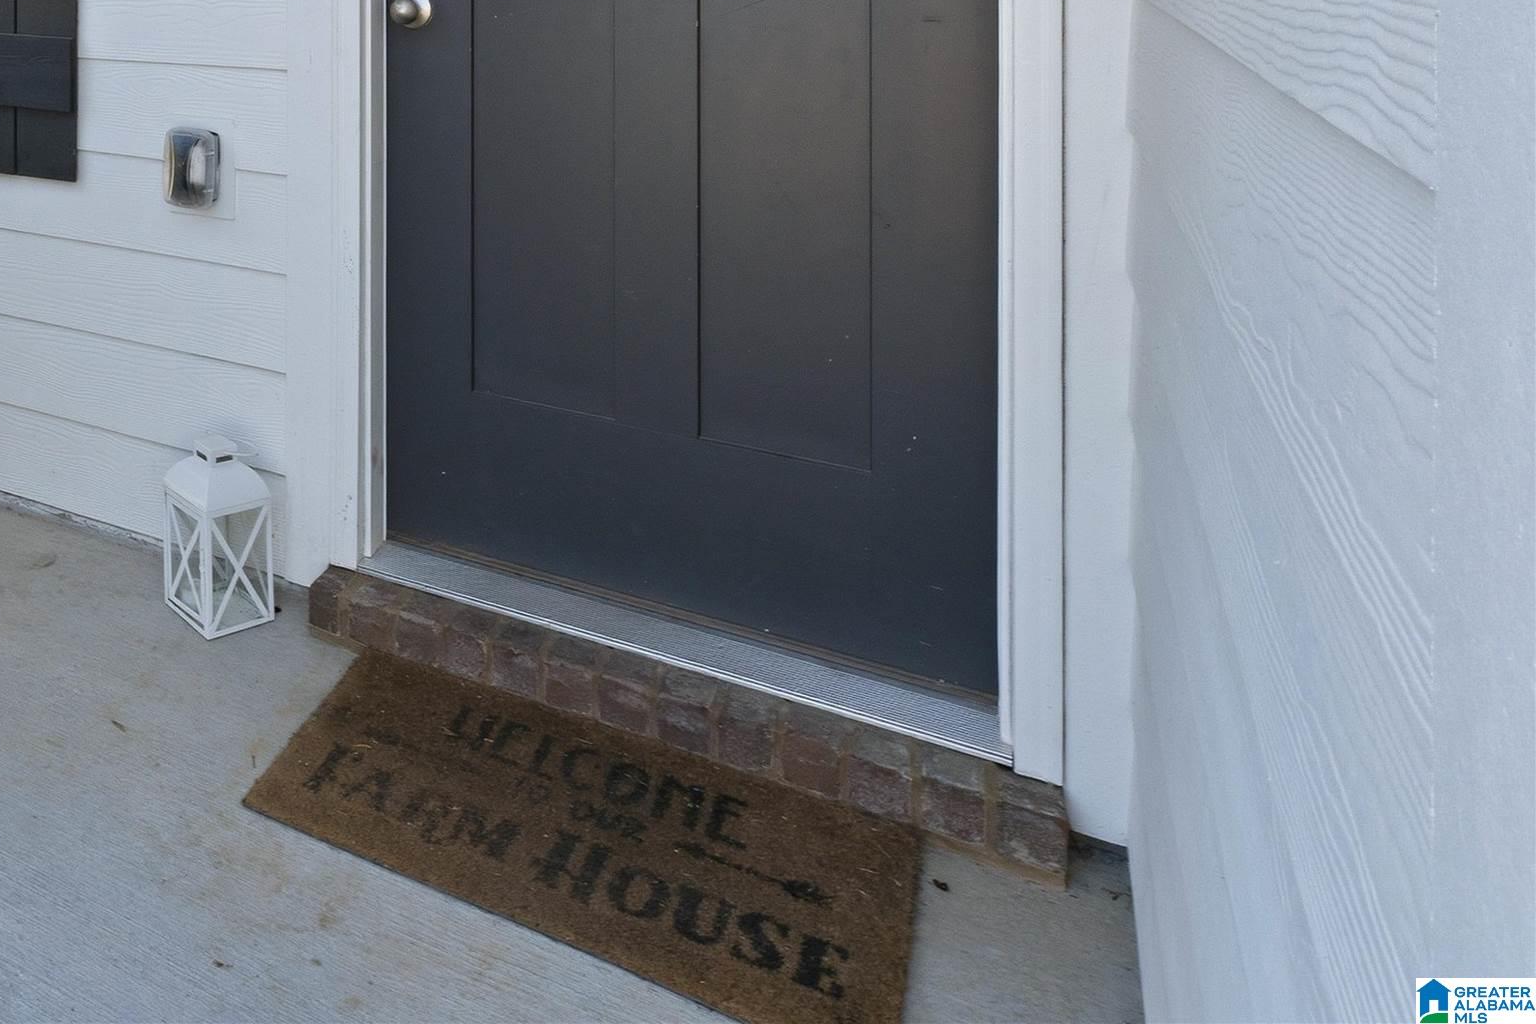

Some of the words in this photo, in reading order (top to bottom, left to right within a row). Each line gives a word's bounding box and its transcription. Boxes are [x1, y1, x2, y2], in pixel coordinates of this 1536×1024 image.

[304, 742, 521, 862] FARM
[530, 830, 852, 999] HOUSE
[447, 704, 748, 851] WELCOME
